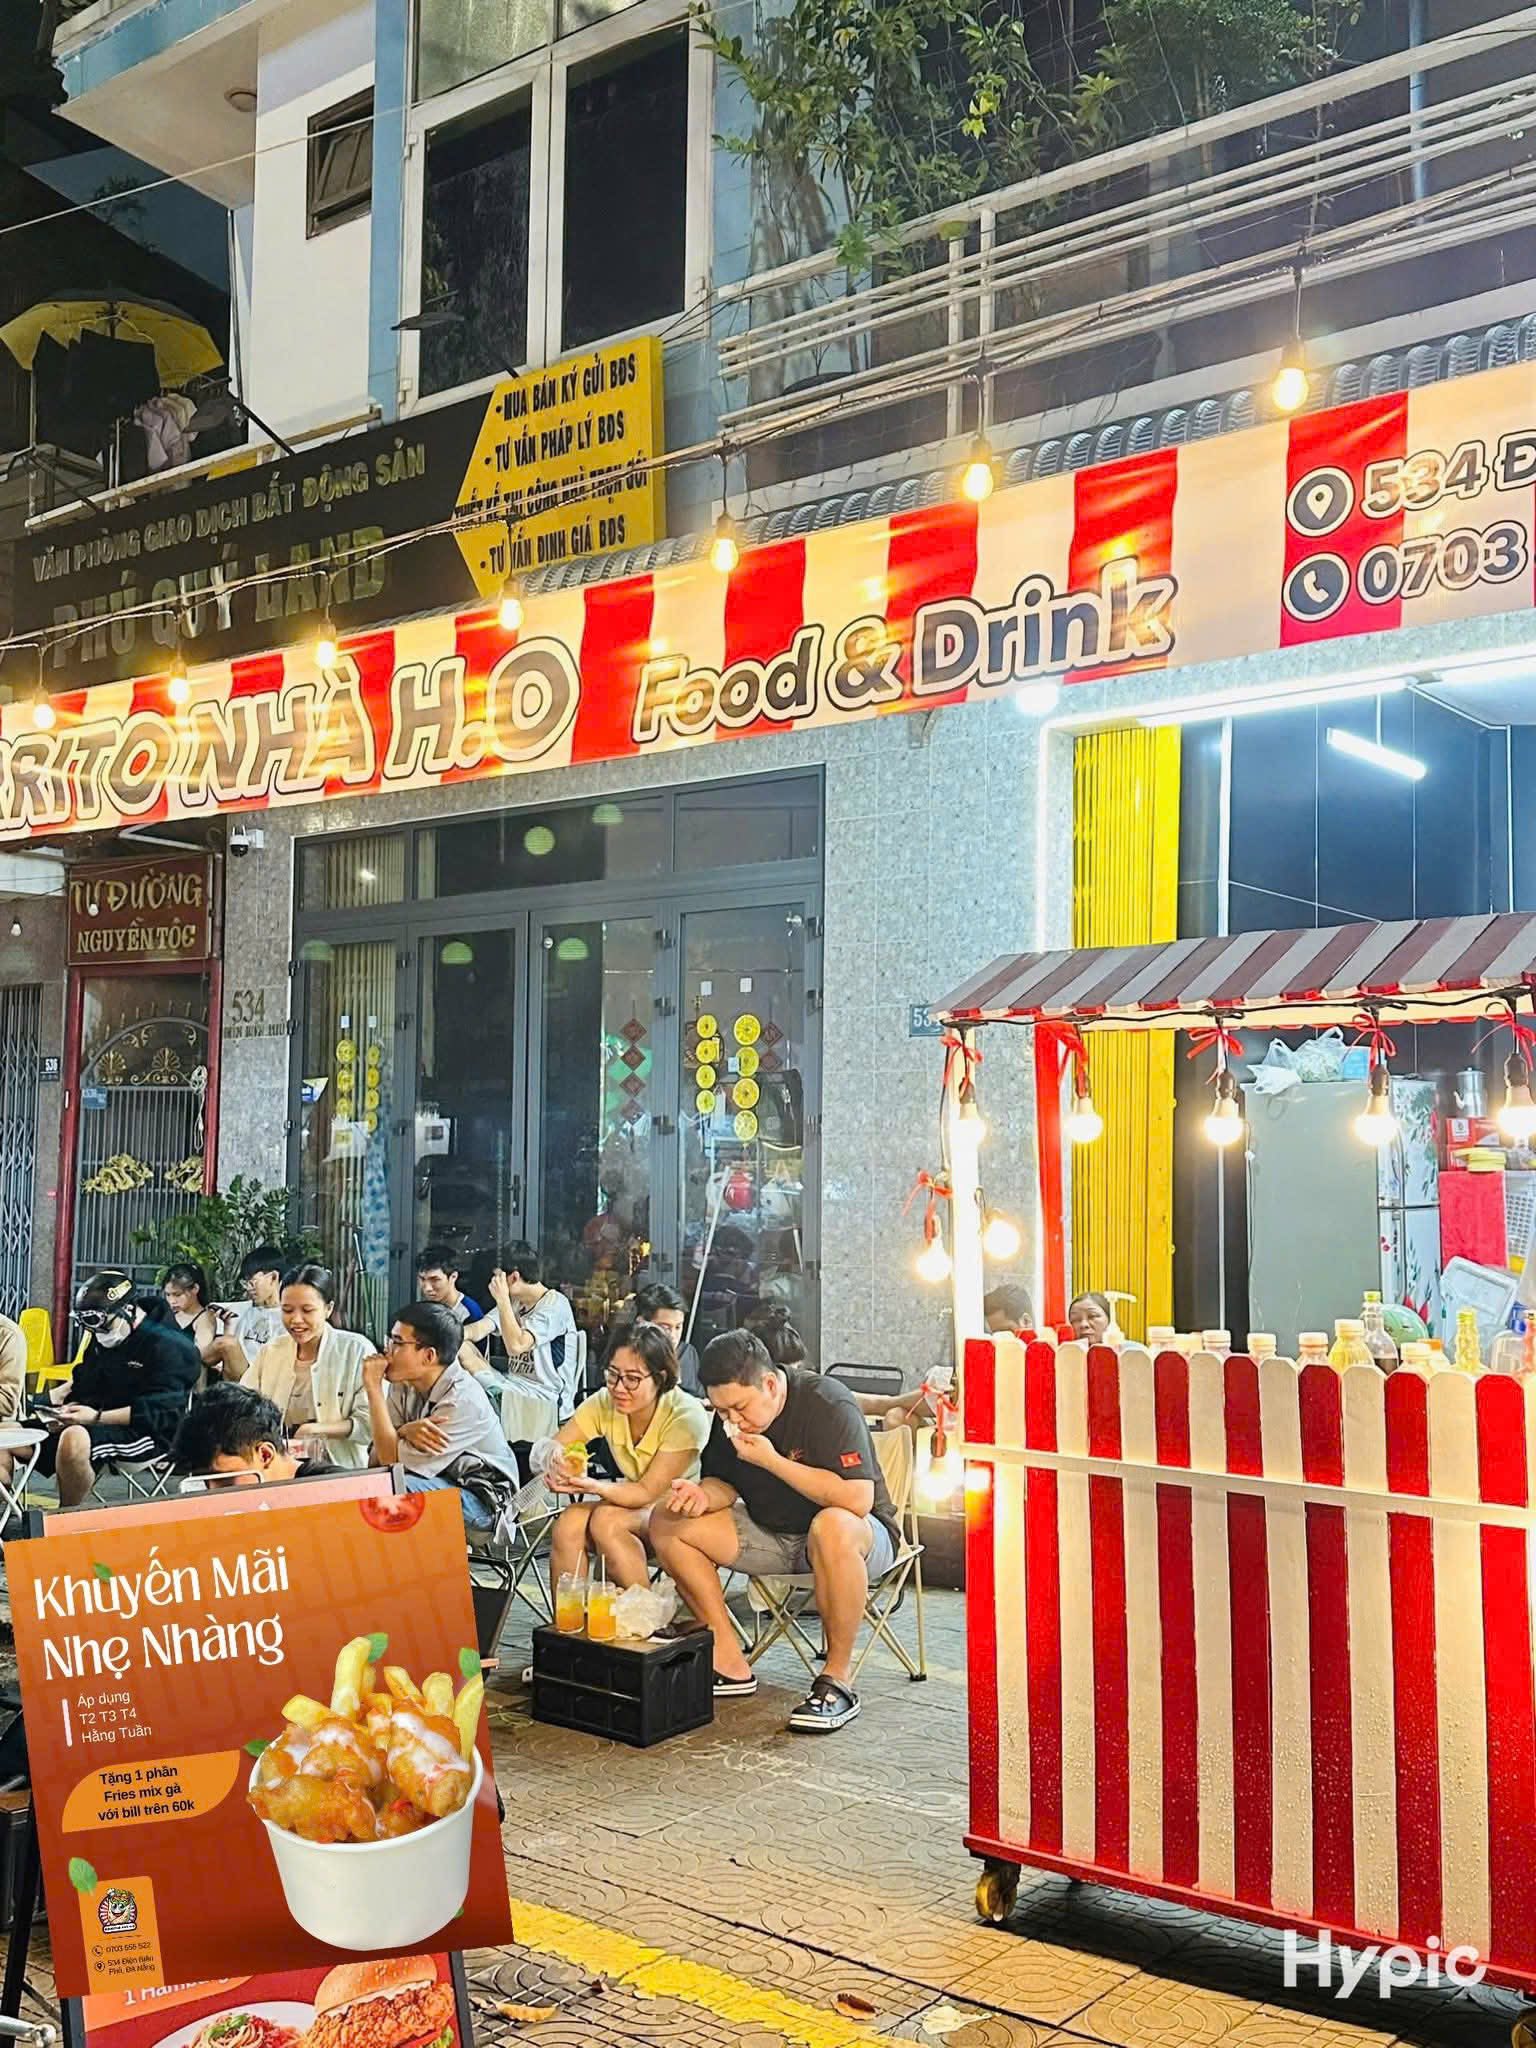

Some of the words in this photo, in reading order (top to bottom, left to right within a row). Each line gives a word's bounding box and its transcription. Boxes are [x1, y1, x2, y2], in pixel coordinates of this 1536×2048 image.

[503, 389, 528, 421] MUA
[533, 371, 557, 412] BÁN
[561, 365, 578, 404] KÝ
[583, 352, 604, 402] GỬI
[610, 353, 636, 389] BĐS
[495, 435, 510, 472] TƯ
[514, 424, 536, 467] VẤN
[541, 420, 573, 460] PHÁP
[578, 411, 592, 450] LÝ
[598, 410, 624, 444] BĐS
[1361, 440, 1489, 520] 534
[32, 542, 70, 583] VĂN
[73, 526, 141, 572] PHÒNG
[144, 513, 193, 554] GIAO
[196, 496, 247, 544] DỊCH
[252, 471, 295, 522] BẤT
[303, 462, 369, 512] ĐỘNG
[376, 437, 424, 488] SẢN
[489, 539, 504, 574] TƯ
[571, 515, 592, 554] GIÁ
[1357, 520, 1528, 605] 0703
[53, 569, 138, 668] PHÚ
[151, 543, 239, 649] QUÝ
[254, 525, 387, 622] LAND
[179, 655, 374, 806] NHÀ
[632, 622, 823, 743] Food
[827, 614, 908, 710] &
[912, 555, 1180, 698] Drink
[106, 867, 202, 912] ĐƯỜNG
[77, 916, 154, 953] NGUYỄN
[232, 989, 265, 1023] 534
[33, 1546, 201, 1620] Khuyến
[211, 1545, 289, 1599] Mãi
[43, 1635, 131, 1680] Nhẹ
[141, 1613, 285, 1668] Nhàng
[77, 1694, 95, 1709] Áp
[98, 1692, 131, 1706] dụng
[79, 1713, 96, 1725] T2
[99, 1710, 117, 1723] T3
[120, 1707, 137, 1720] T4
[118, 1724, 152, 1739] Tuần
[99, 1771, 132, 1786] Tặng
[136, 1769, 143, 1780] 1
[146, 1766, 178, 1782] phần
[104, 1789, 136, 1802] Fries
[139, 1785, 162, 1798] mix
[165, 1782, 182, 1798] gà
[98, 1806, 119, 1821] với
[122, 1805, 141, 1819] bill
[144, 1803, 169, 1816] trên
[172, 1799, 195, 1812] 60k
